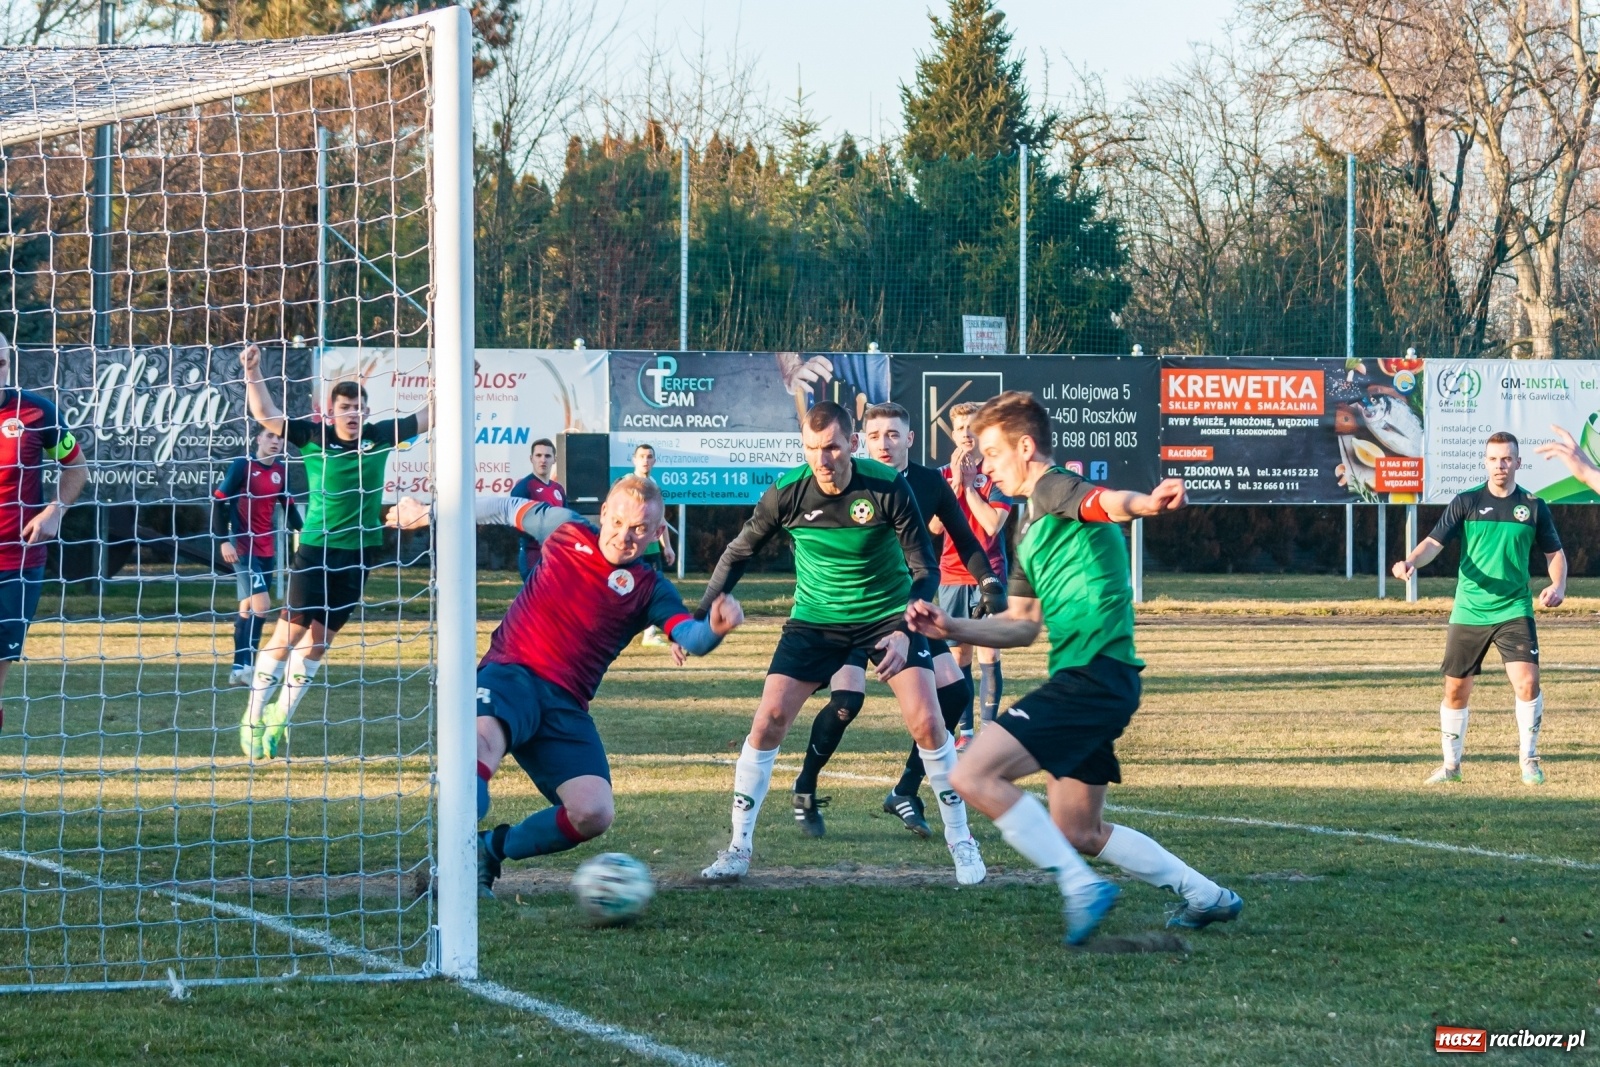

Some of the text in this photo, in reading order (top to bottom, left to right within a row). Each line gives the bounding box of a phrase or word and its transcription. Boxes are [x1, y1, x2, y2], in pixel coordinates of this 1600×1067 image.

[645, 369, 695, 407] TEAM
[1168, 374, 1318, 399] KREWETKA
[1501, 377, 1599, 390] GM-INSTAL tel.
[486, 392, 519, 402] Michna
[1043, 383, 1131, 404] ul. Kolejowa 5
[1500, 391, 1570, 401] Marek Gawliczek
[1168, 400, 1318, 411] SKLEP RYBNY & SMAŻALNIA
[1438, 399, 1478, 408] GM-INSTAL
[1082, 407, 1137, 424] Roszków
[623, 414, 729, 428] AGENCJA PRACY
[1168, 416, 1319, 429] RYBY ŚWIEŻE, MROŻONE, WĘDZONE
[1200, 428, 1231, 436] MORSKIE
[1236, 428, 1287, 436] SŁODKOWODNE
[1441, 424, 1494, 434] instalacje C.O.
[118, 434, 255, 447] SKLEP ODZIEŻOWY
[700, 438, 783, 449] POSZUKUJEMY
[1062, 431, 1086, 448] 698
[1089, 431, 1110, 448] 061
[1114, 431, 1138, 448] 803
[1441, 437, 1477, 447] instalacje
[730, 453, 746, 463] DO
[749, 450, 793, 463] BRANŻY
[1168, 448, 1208, 458] RACIBÓRZ
[1440, 450, 1477, 459] instalacje
[1380, 460, 1419, 468] U NAS RYBY
[1440, 462, 1476, 472] instalacje
[1168, 466, 1319, 477] UL. ZBOROWA 5A tel. 32 415 22 32
[1381, 470, 1419, 478] Z WŁASNEJ
[661, 472, 688, 485] 603
[692, 472, 717, 485] 251
[722, 472, 748, 486] 118
[751, 472, 774, 485] lub
[1440, 475, 1467, 484] pompy
[1184, 480, 1299, 490] OCICKA 5 tel. 32 666 0 111
[1384, 480, 1419, 489] WĘDZARNI
